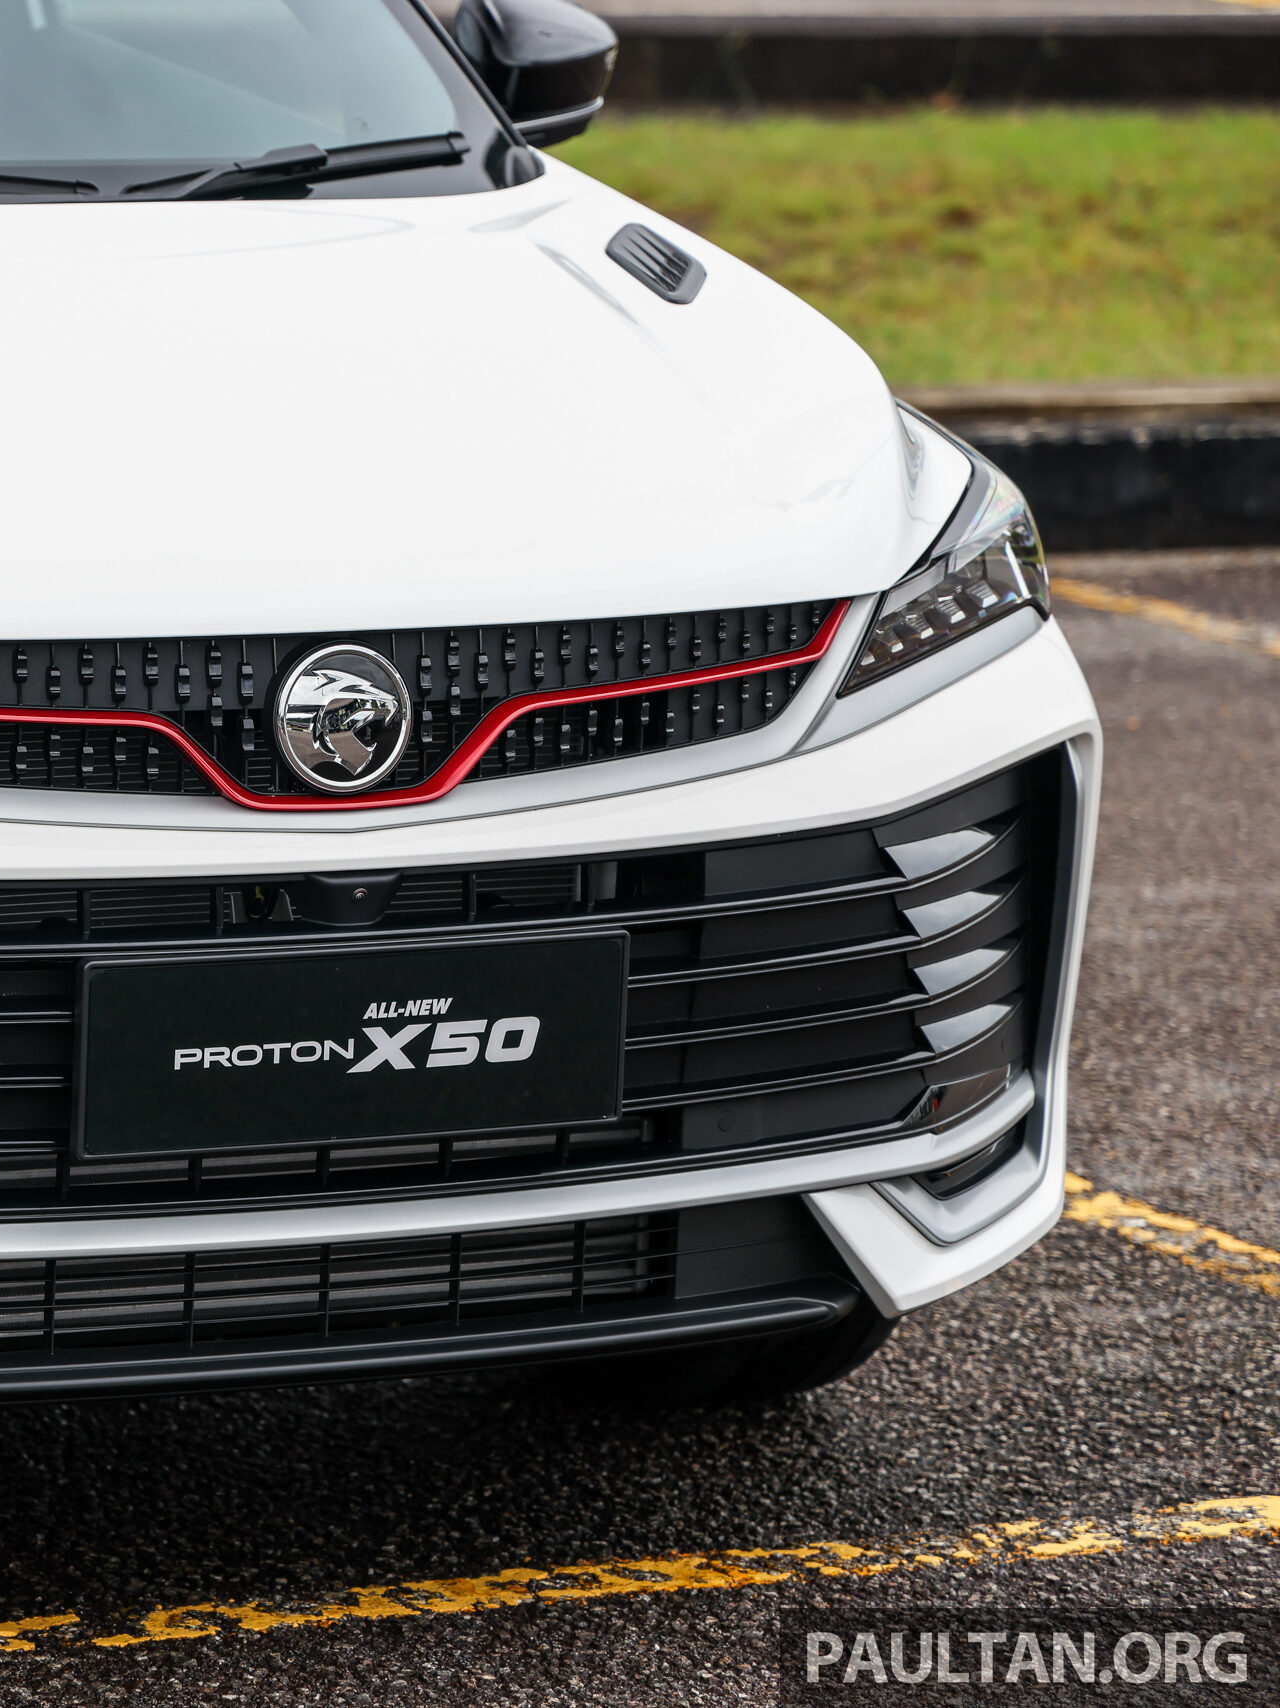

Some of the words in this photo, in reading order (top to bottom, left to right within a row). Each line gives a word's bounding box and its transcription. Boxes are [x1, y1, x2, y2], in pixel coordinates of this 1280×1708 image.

[363, 998, 454, 1020] ALL-NEW
[174, 1038, 355, 1071] PROTON
[345, 1016, 541, 1074] X50
